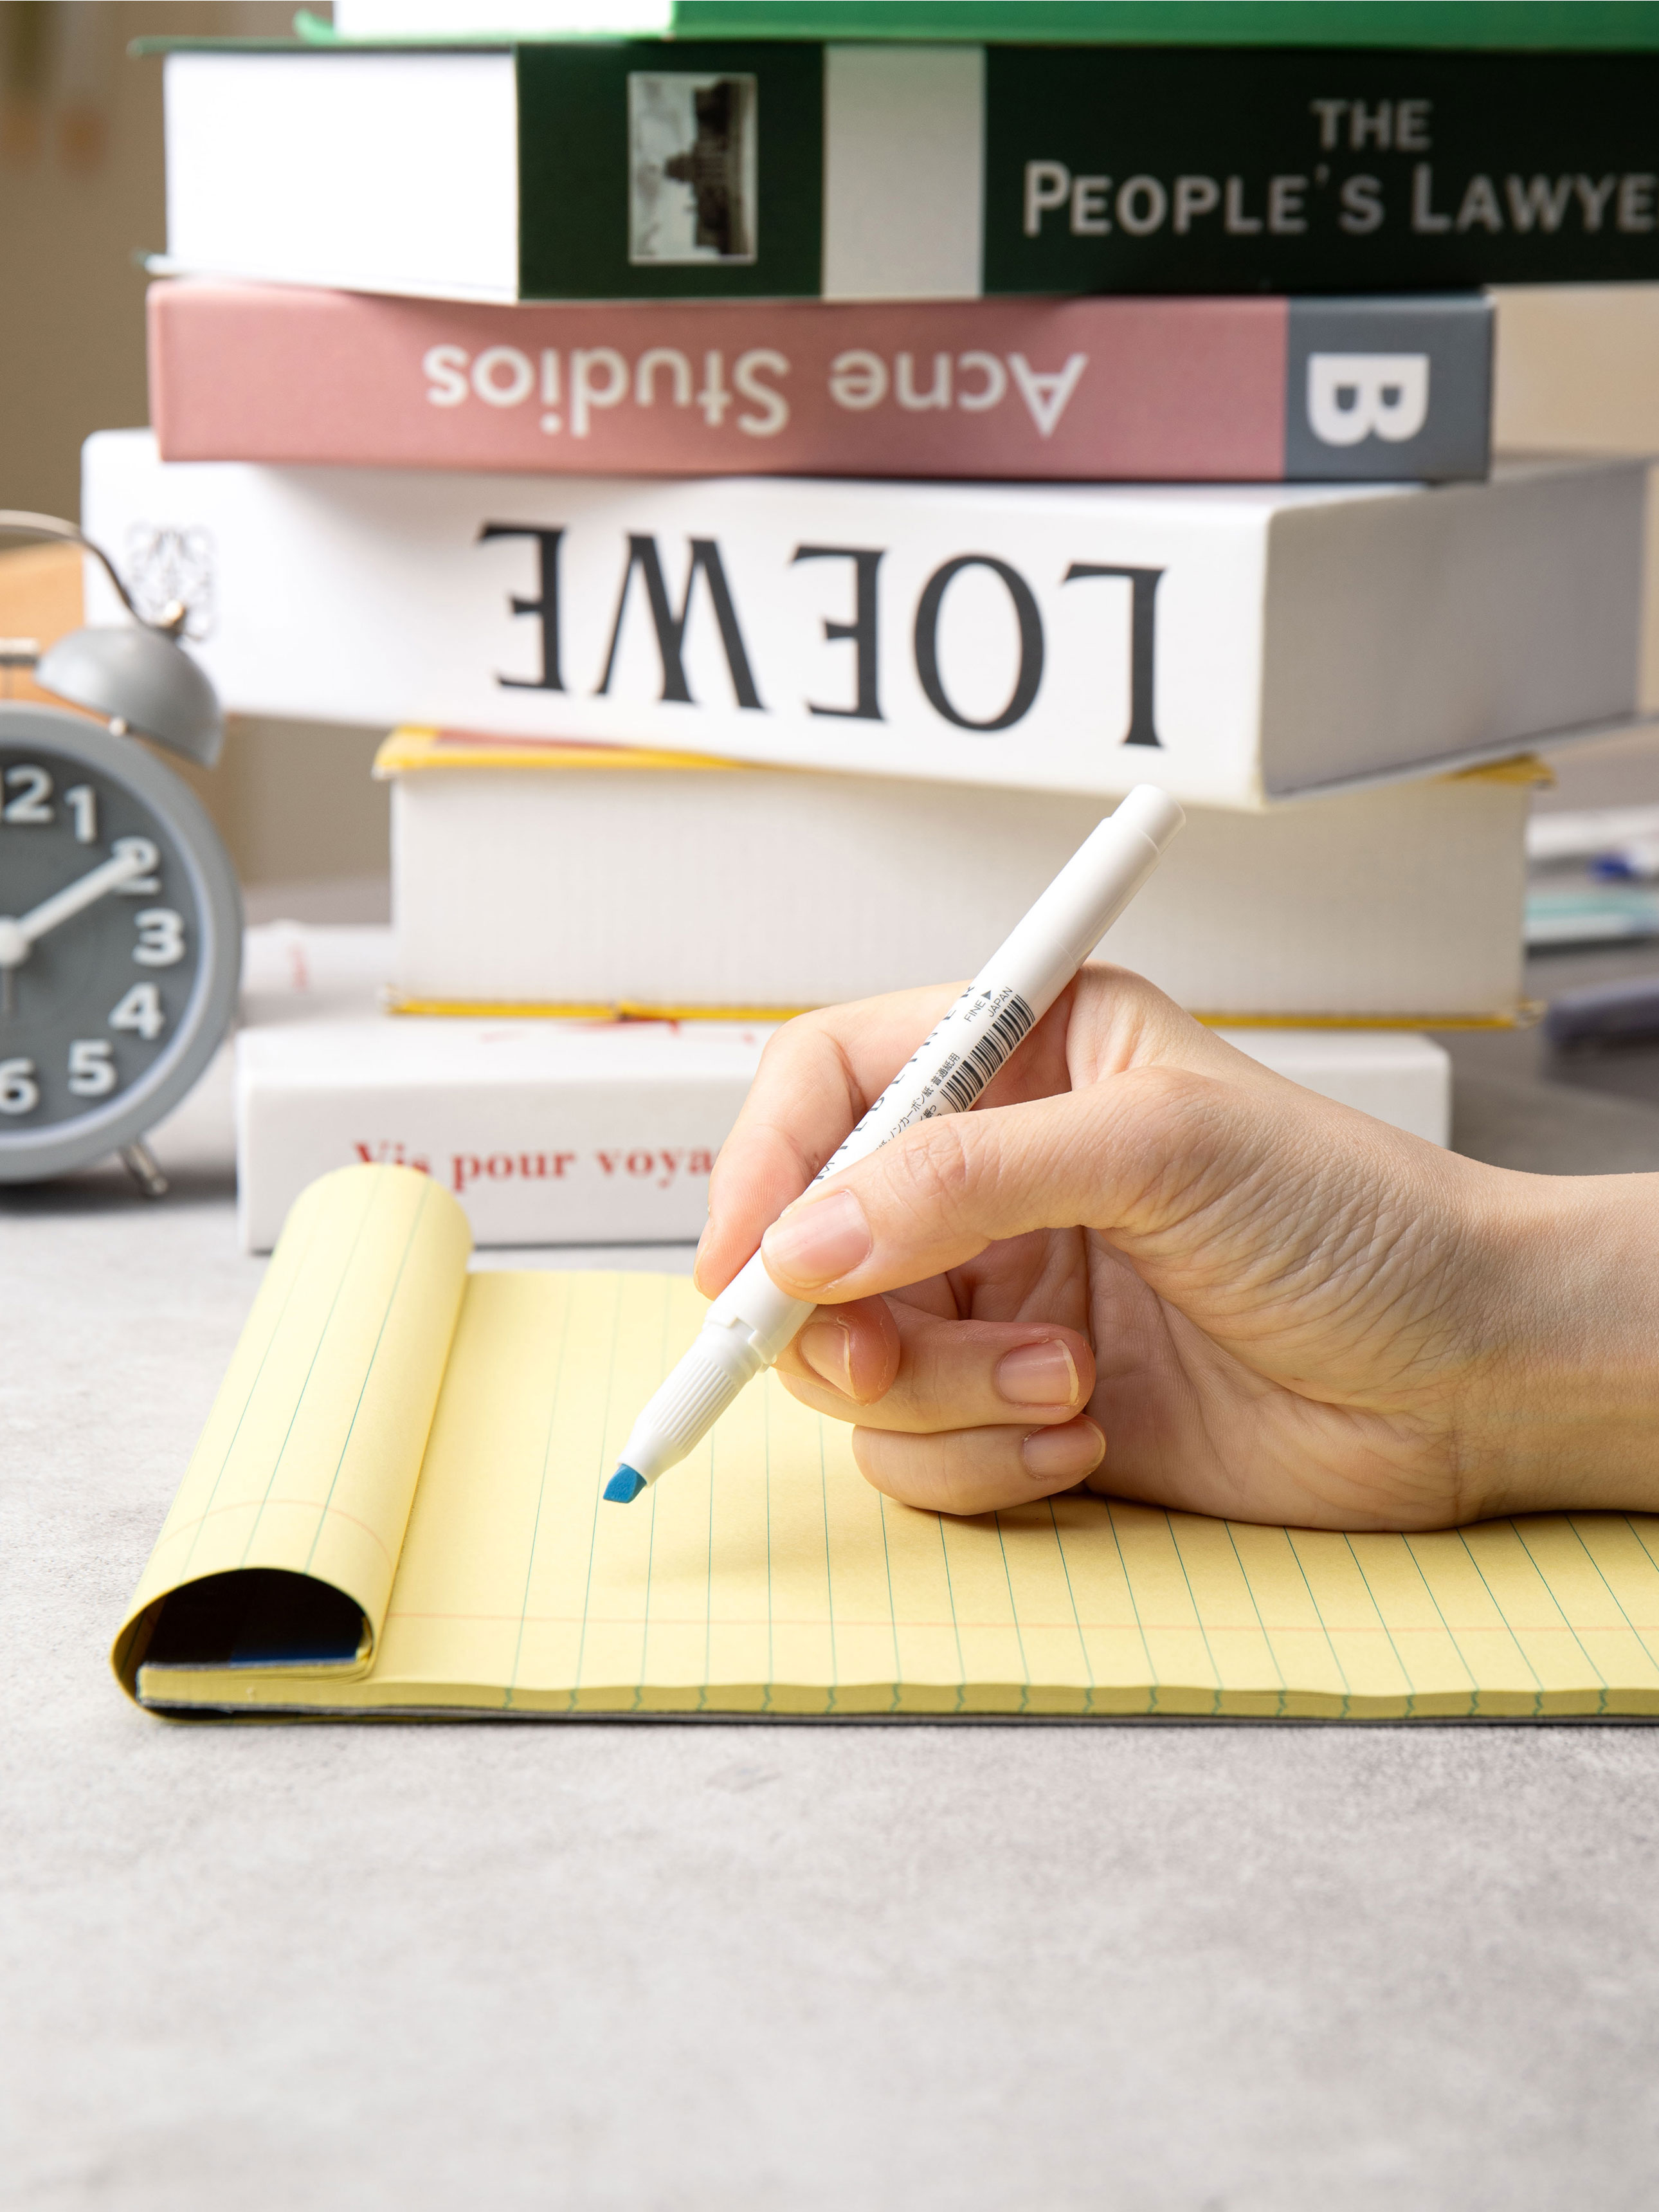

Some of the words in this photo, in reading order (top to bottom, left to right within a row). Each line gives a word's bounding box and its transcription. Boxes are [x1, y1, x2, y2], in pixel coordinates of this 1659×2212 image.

[1310, 100, 1430, 150] THE
[423, 345, 792, 436] Studios
[828, 351, 1088, 437] Acne
[1307, 354, 1429, 446] B
[476, 519, 1168, 750] LOEWE
[0, 765, 54, 823] 2
[66, 785, 96, 842] 1
[133, 908, 185, 965] 3
[109, 983, 164, 1039] 4
[964, 1000, 986, 1022] FINE
[988, 986, 1013, 1018] JAPAN
[0, 1057, 39, 1115] 6
[69, 1039, 116, 1094] 5
[452, 1149, 575, 1193] pour
